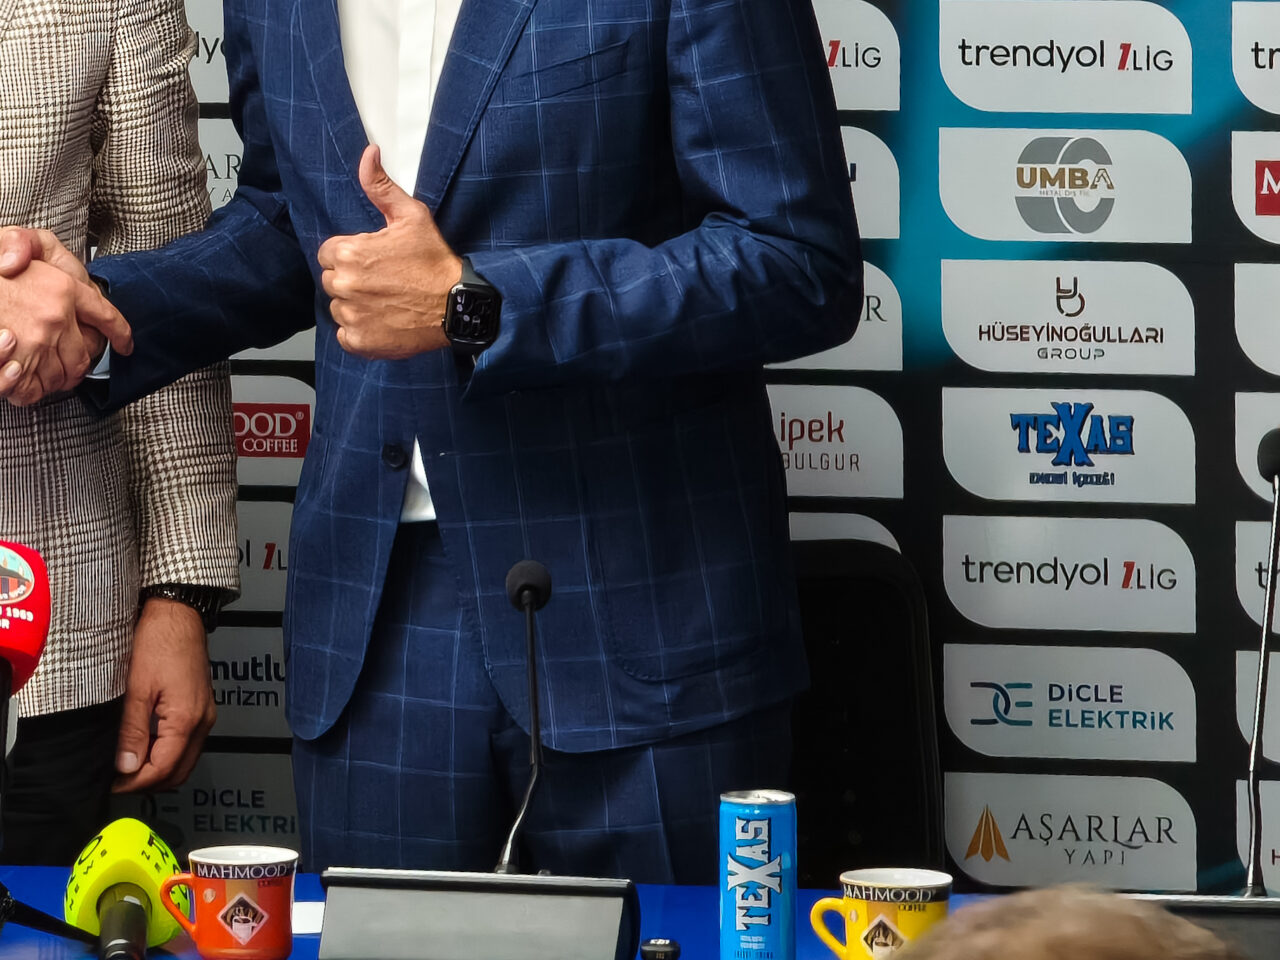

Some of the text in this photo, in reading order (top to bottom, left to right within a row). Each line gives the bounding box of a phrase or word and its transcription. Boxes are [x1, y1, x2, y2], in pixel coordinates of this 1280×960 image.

[958, 39, 1105, 73] trendyol
[1016, 166, 1115, 190] UMBA
[1037, 347, 1105, 360] GROUP
[1010, 401, 1135, 467] TEXAS
[242, 438, 298, 453] COFFEE
[962, 554, 1108, 590] trendyol
[6, 607, 34, 622] 1969
[214, 686, 279, 707] urizm
[1010, 813, 1178, 850] AŞARLAR
[1064, 848, 1127, 866] YAPI
[197, 863, 287, 879] MAHMOOD
[727, 816, 782, 931] TEXAS
